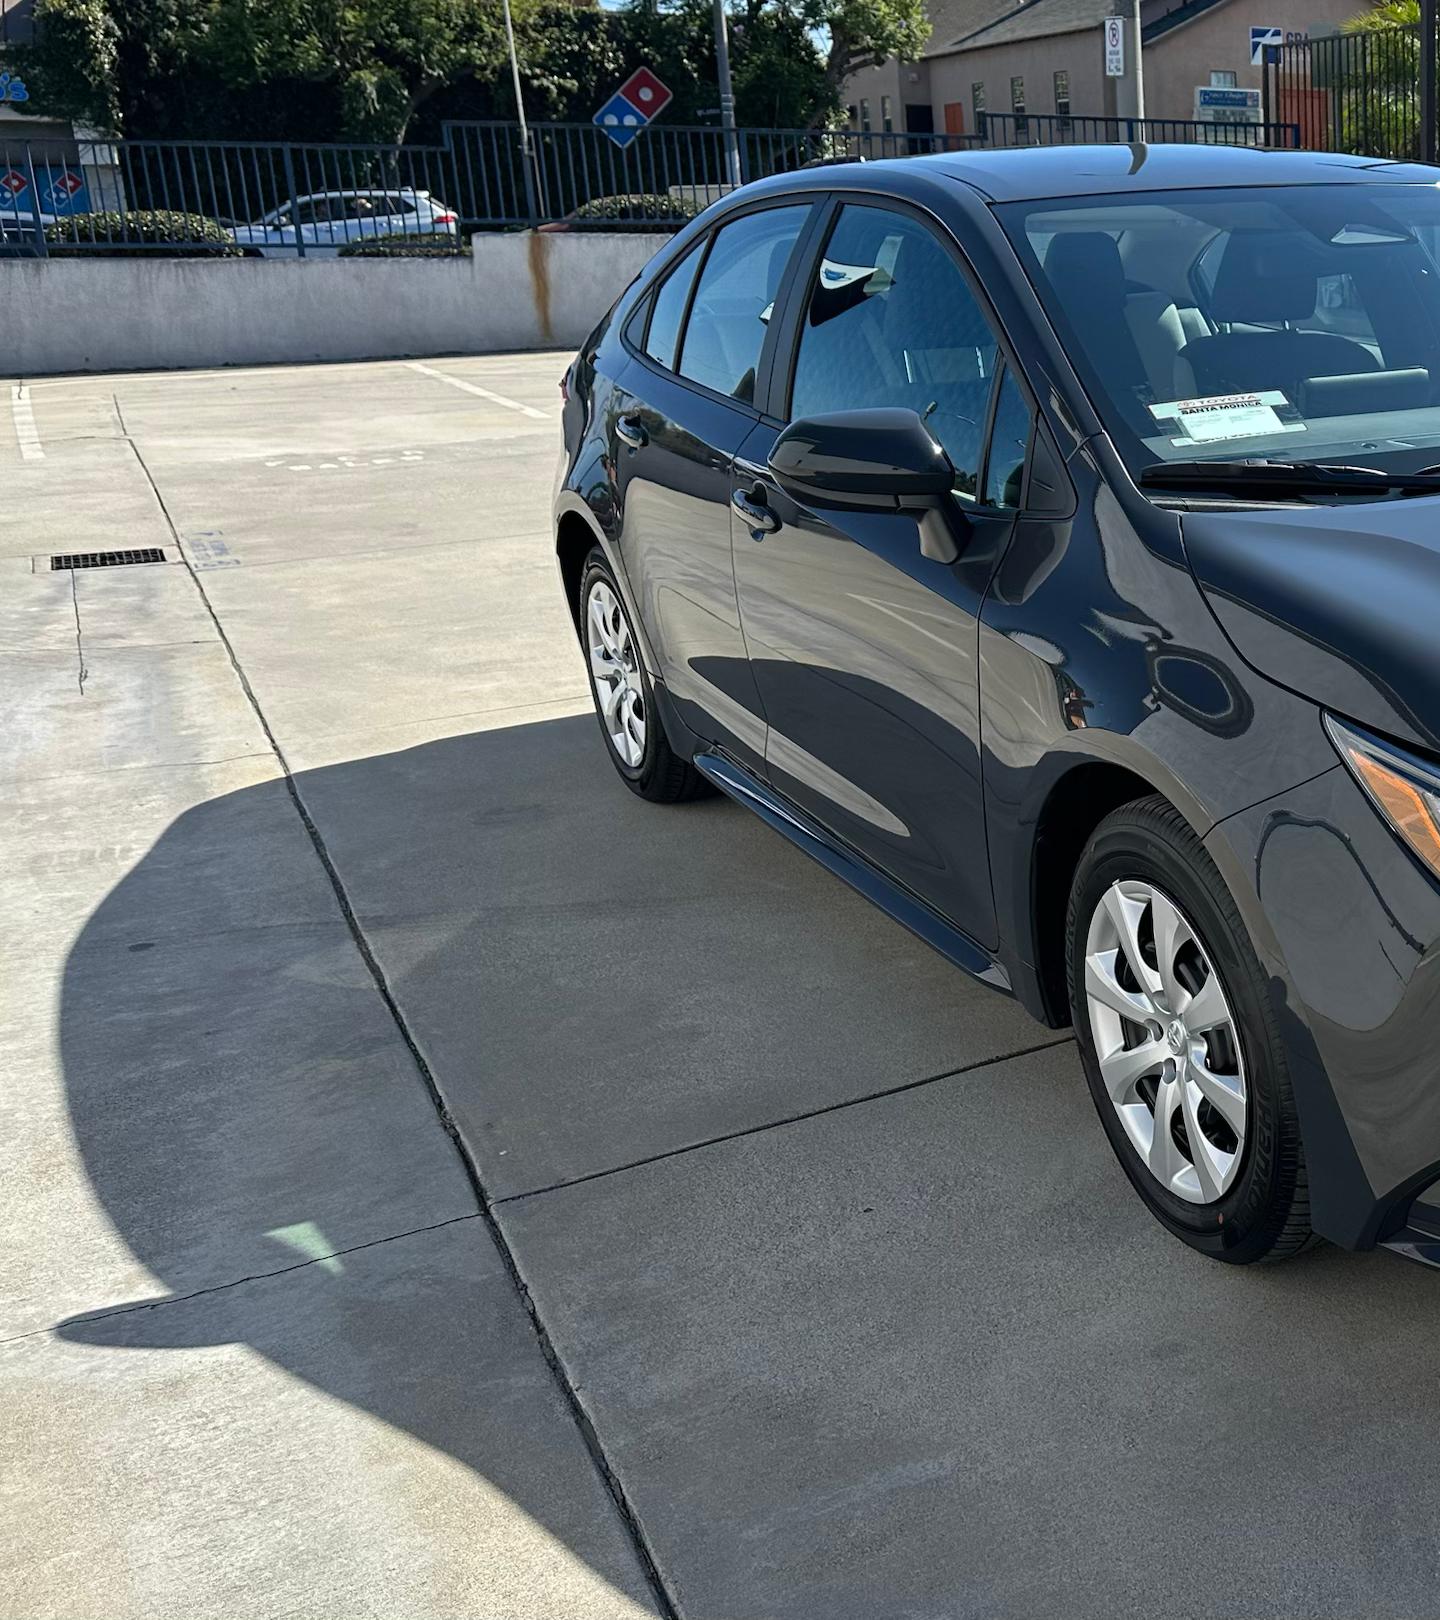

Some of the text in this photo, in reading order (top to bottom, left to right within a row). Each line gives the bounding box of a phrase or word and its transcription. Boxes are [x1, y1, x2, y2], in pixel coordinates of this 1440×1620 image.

[1197, 395, 1257, 407] TOYOTA
[1181, 402, 1262, 415] SANTA MONICA
